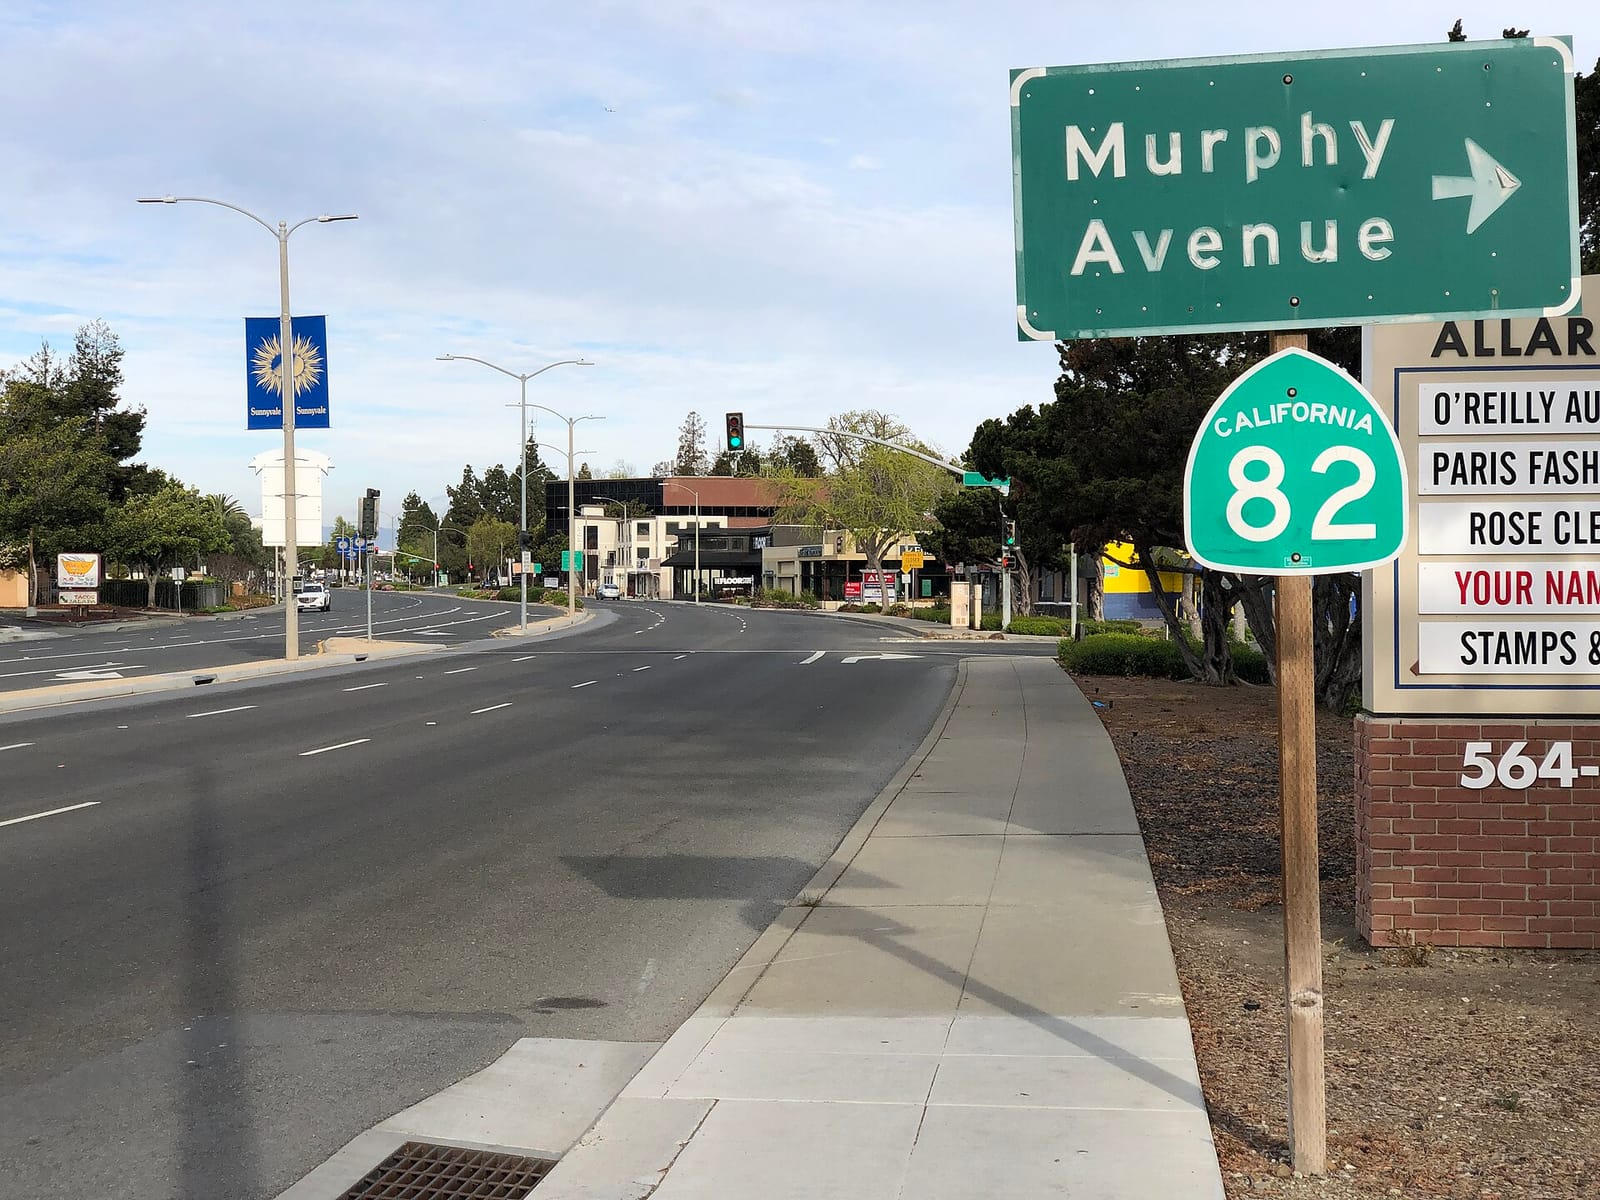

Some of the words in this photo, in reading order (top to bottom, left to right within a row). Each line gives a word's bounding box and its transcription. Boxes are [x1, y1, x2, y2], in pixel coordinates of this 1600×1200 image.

[1065, 111, 1396, 184] Murphy
[1070, 217, 1395, 276] Avenue
[1431, 318, 1597, 358] ALLAR
[251, 406, 282, 417] Sunnyvale
[296, 405, 327, 416] Sunnyvale
[1214, 401, 1373, 437] CALIFORNIA
[1434, 391, 1556, 425] O'REILLY
[1565, 391, 1600, 424] AU
[1433, 451, 1517, 485] PARIS
[1529, 451, 1599, 485] FASH
[1226, 445, 1377, 542] 82
[1470, 511, 1542, 545] ROSE
[1554, 511, 1600, 545] CLE
[1455, 570, 1533, 605] YOUR
[1461, 630, 1577, 666] STAMPS
